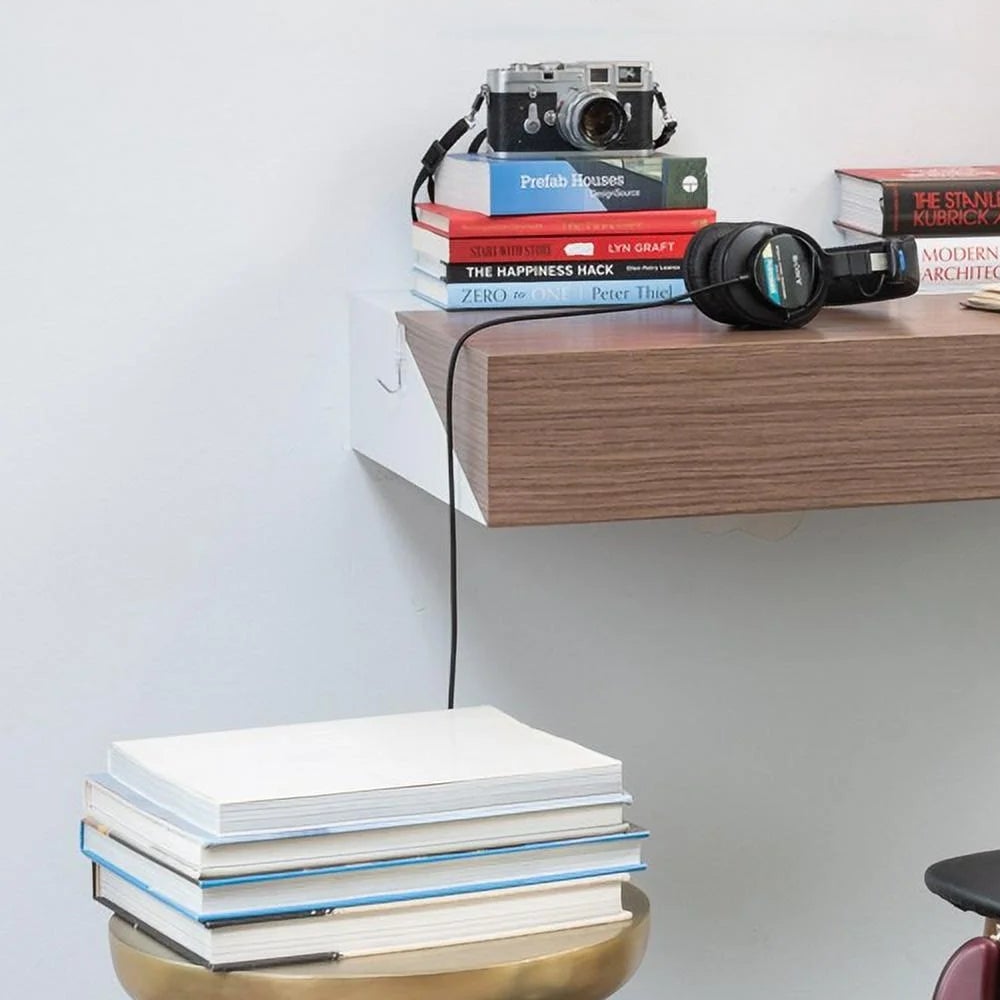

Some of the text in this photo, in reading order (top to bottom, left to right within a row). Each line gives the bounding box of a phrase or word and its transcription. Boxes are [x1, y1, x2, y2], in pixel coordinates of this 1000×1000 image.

[519, 173, 625, 189] Prefab Houses
[912, 191, 941, 210] THE
[913, 208, 989, 227] KUBRICK
[608, 241, 675, 253] LYN GRAFT
[922, 246, 999, 263] MODERN
[466, 264, 615, 278] THE HAPPINESS HACK
[461, 288, 507, 304] ZERO
[513, 291, 526, 300] to
[591, 286, 631, 301] Peter
[635, 284, 673, 300] Thiel
